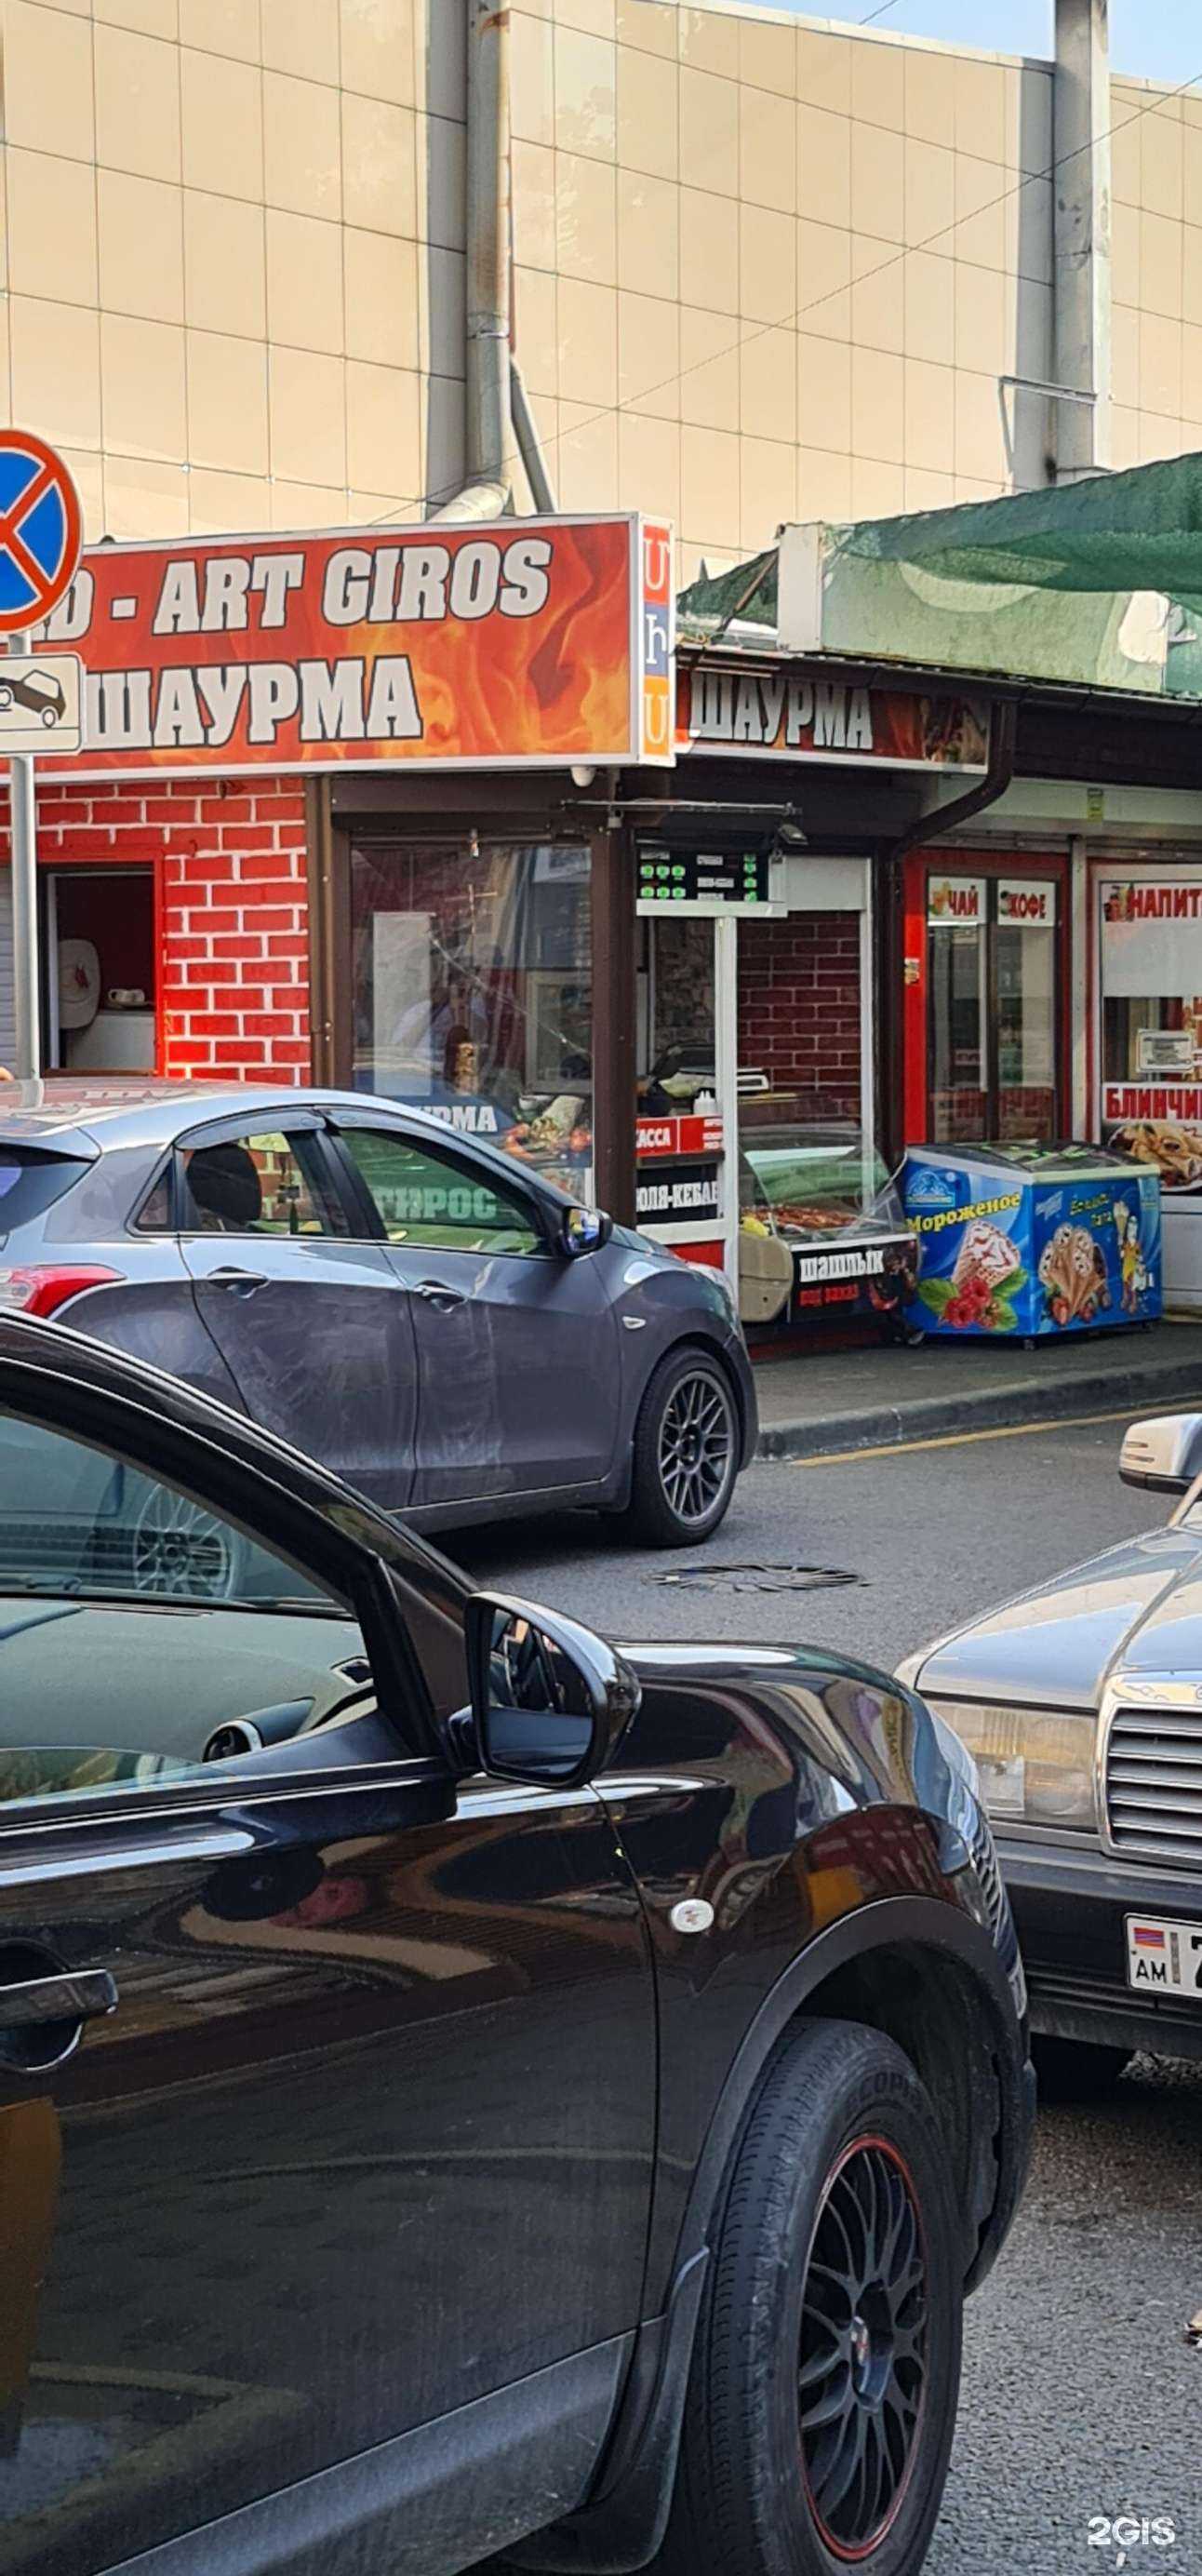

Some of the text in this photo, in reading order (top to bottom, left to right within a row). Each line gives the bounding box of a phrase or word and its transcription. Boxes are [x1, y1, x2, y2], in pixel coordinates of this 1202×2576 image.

[110, 596, 139, 621] -
[151, 553, 306, 636] ART
[321, 537, 554, 627] GIROS
[86, 654, 424, 752] ШАУРМА
[689, 668, 874, 750] ШАУРМА
[947, 885, 979, 917] ЧАЙ
[1008, 892, 1047, 920] КОФЕ
[1106, 1087, 1202, 1120] БЛИНЧИ
[905, 1191, 1021, 1233] Мороженое
[1135, 1958, 1168, 1984] AM
